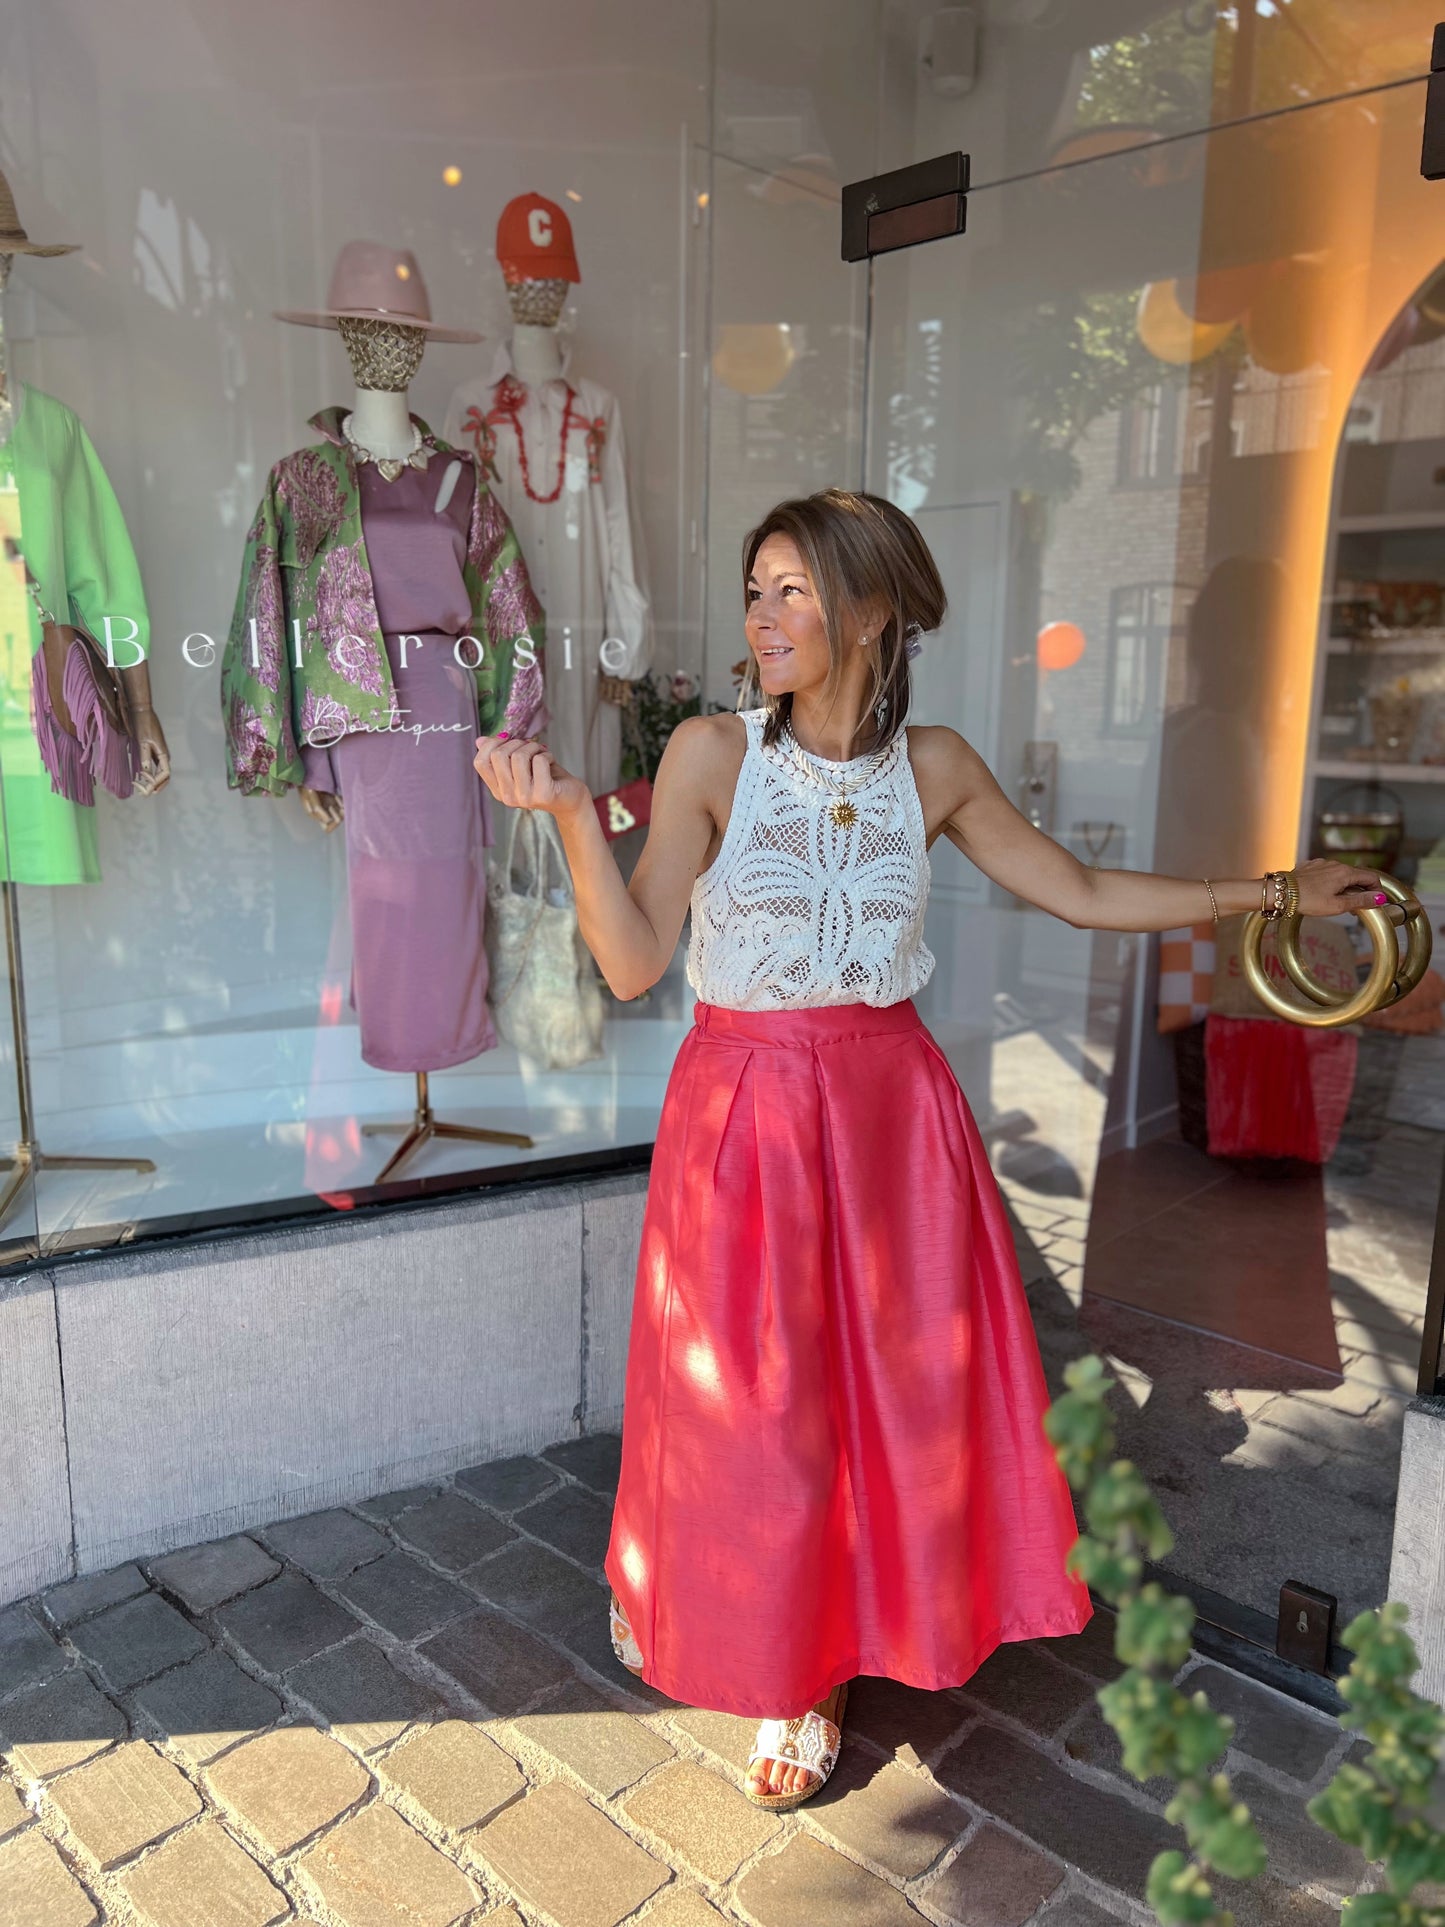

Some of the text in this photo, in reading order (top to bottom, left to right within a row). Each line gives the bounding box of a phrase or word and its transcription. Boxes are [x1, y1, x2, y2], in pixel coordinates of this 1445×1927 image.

[528, 208, 553, 247] C
[101, 615, 628, 669] Bellerosie
[307, 698, 473, 748] Boutique
